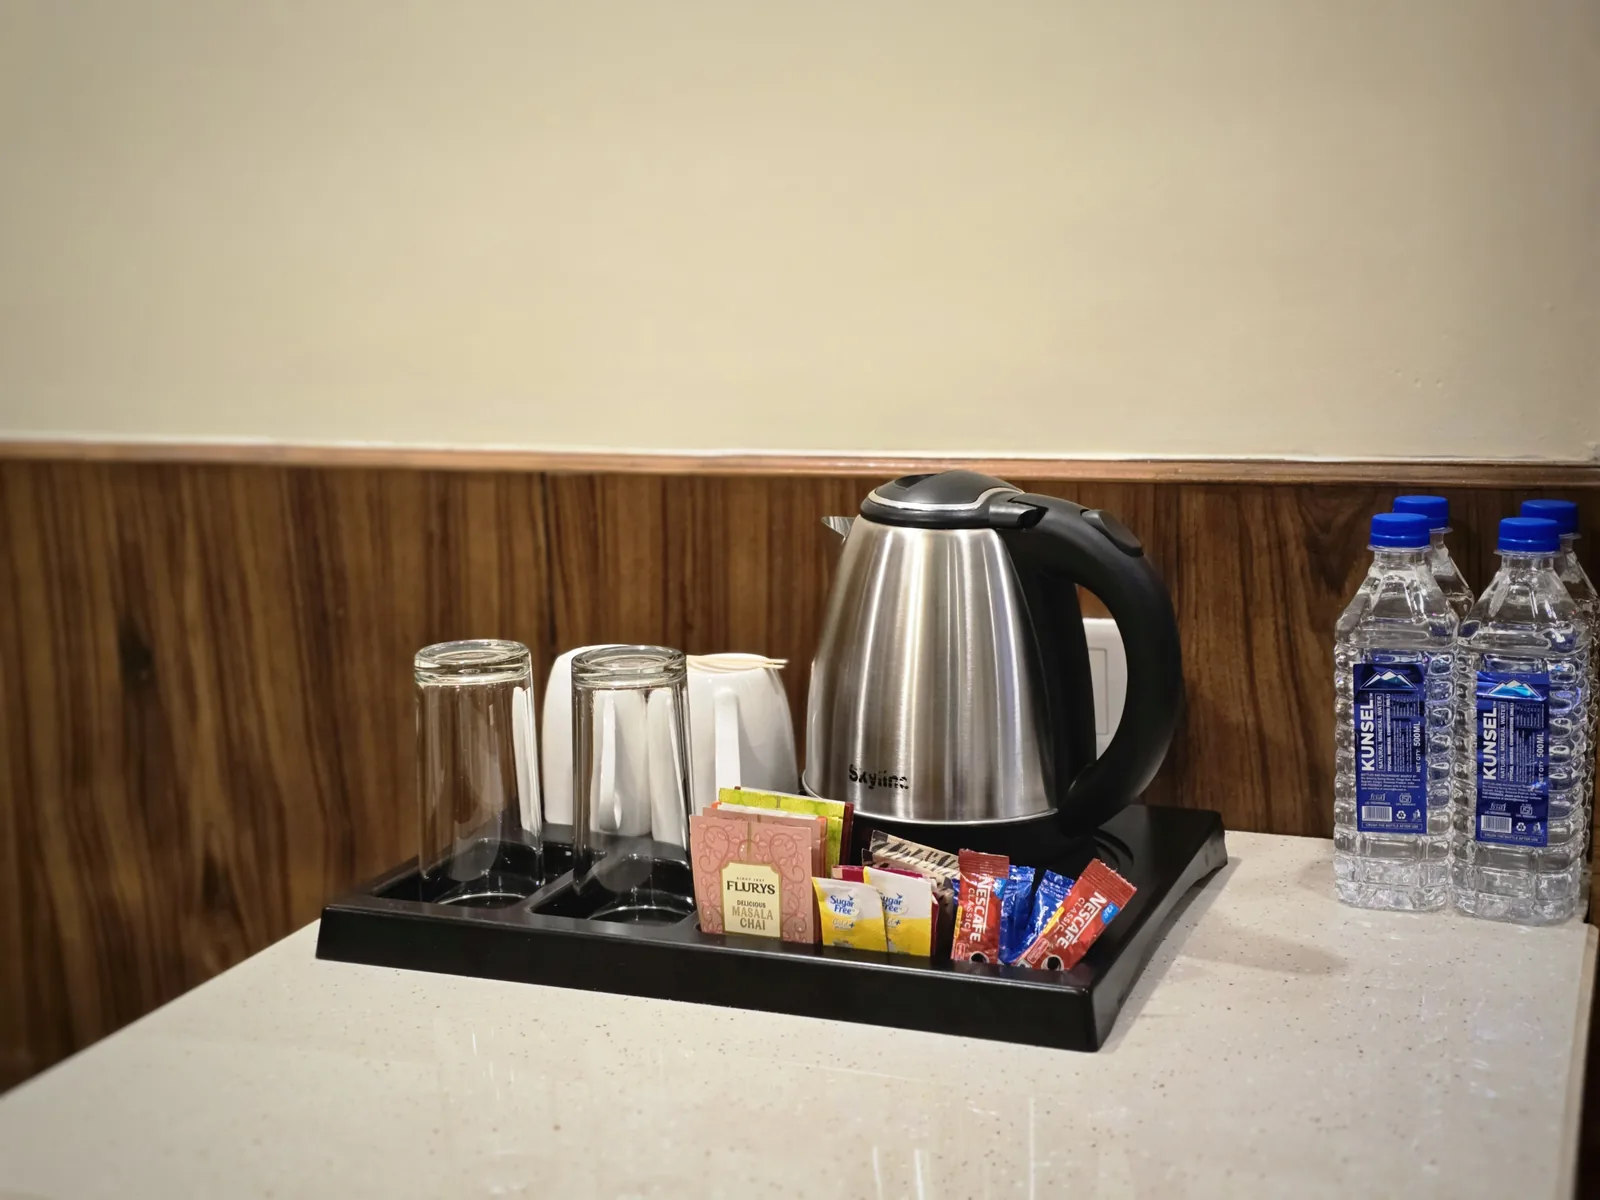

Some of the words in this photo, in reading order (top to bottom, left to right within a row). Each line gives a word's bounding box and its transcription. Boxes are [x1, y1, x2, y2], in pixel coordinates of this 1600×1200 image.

[1360, 699, 1375, 771] KUNSEL
[1483, 707, 1497, 780] KUNSEL
[727, 880, 776, 895] FLURYS
[736, 900, 767, 909] DELICIOUS
[830, 894, 855, 908] Sugar
[881, 896, 903, 906] ugar
[964, 887, 975, 929] CLASSIC
[732, 906, 774, 921] MASALA
[834, 904, 853, 915] Free
[1057, 897, 1085, 932] CLASSIC
[740, 917, 766, 931] CHAI
